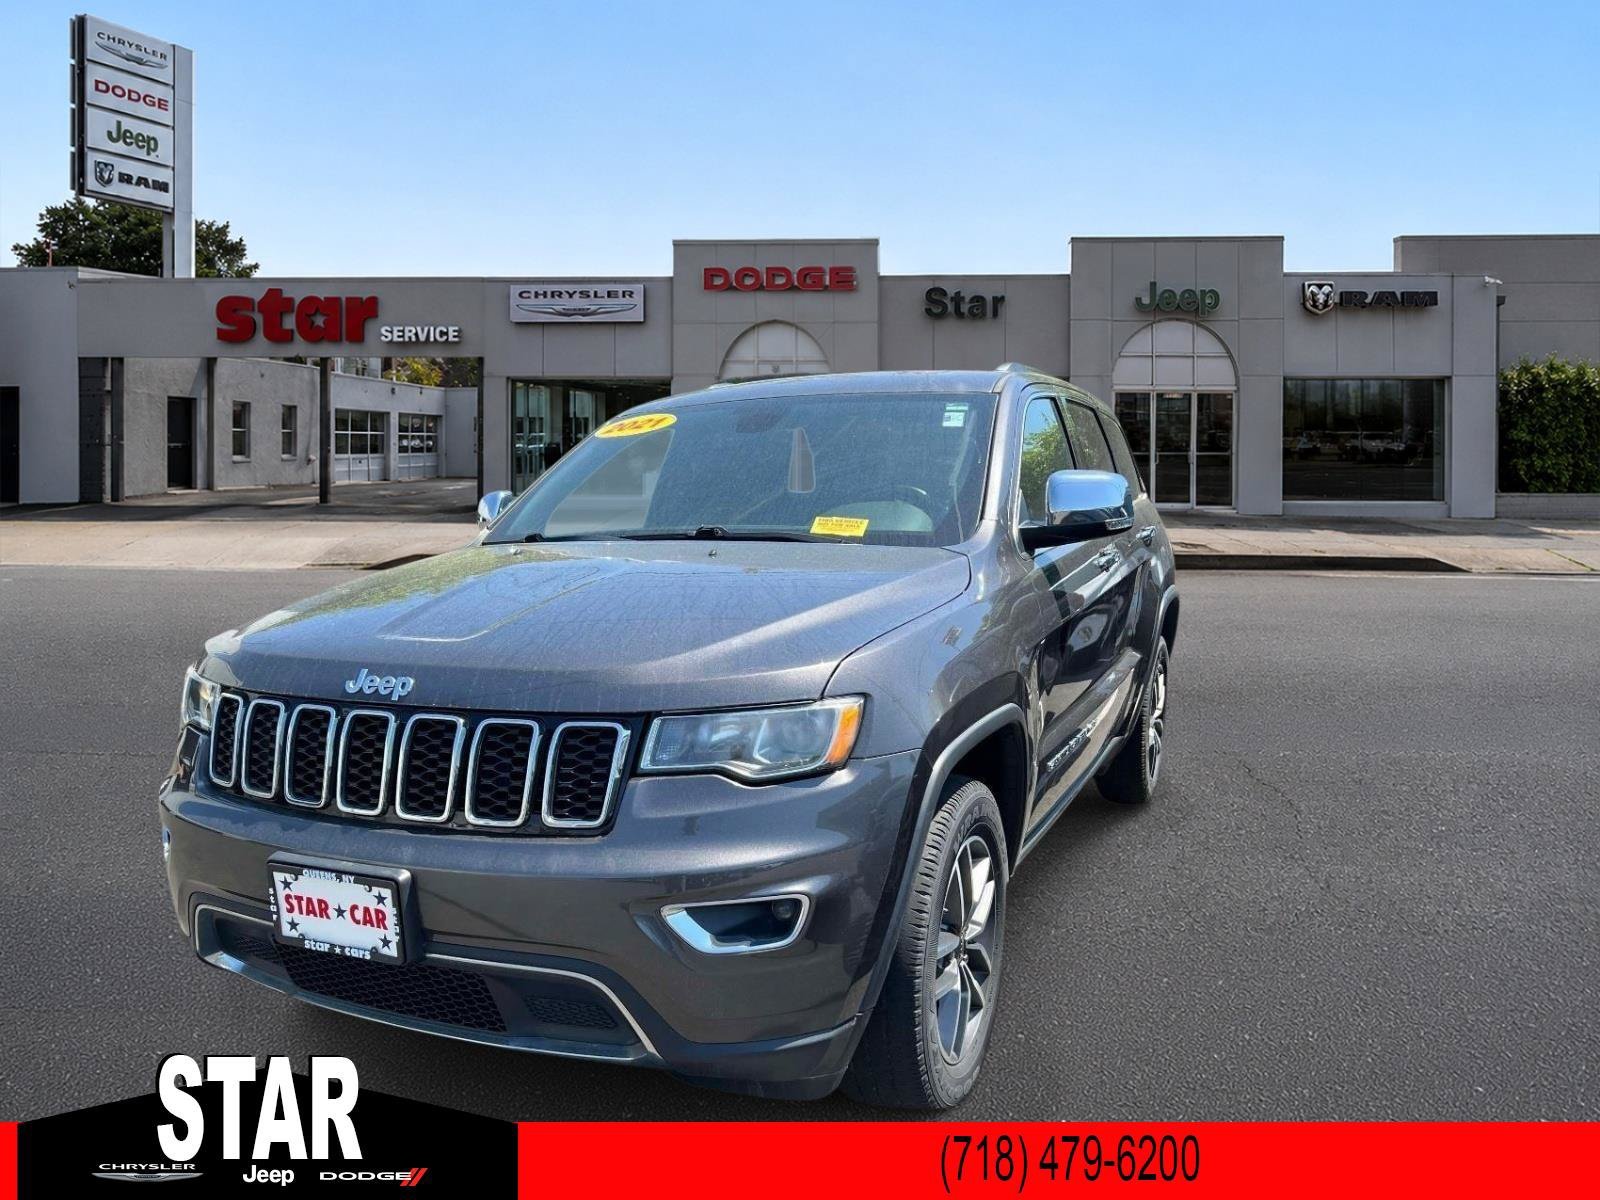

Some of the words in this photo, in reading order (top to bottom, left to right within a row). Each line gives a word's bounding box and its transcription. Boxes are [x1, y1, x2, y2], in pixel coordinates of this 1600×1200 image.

[97, 31, 168, 61] CHRYSLER
[94, 79, 169, 111] DODGE
[107, 120, 159, 156] Jeep
[118, 171, 169, 193] RAM
[703, 266, 857, 291] DODGE
[518, 290, 635, 299] CHRYSLER
[923, 286, 1006, 320] Star
[1134, 281, 1221, 316] Jeep
[1339, 290, 1439, 307] RAM
[215, 287, 379, 344] star
[380, 325, 461, 343] SERVICE
[345, 668, 414, 701] Jeep
[284, 893, 331, 920] STAR
[349, 903, 389, 931] CAR
[304, 939, 330, 953] star
[344, 946, 371, 960] cars
